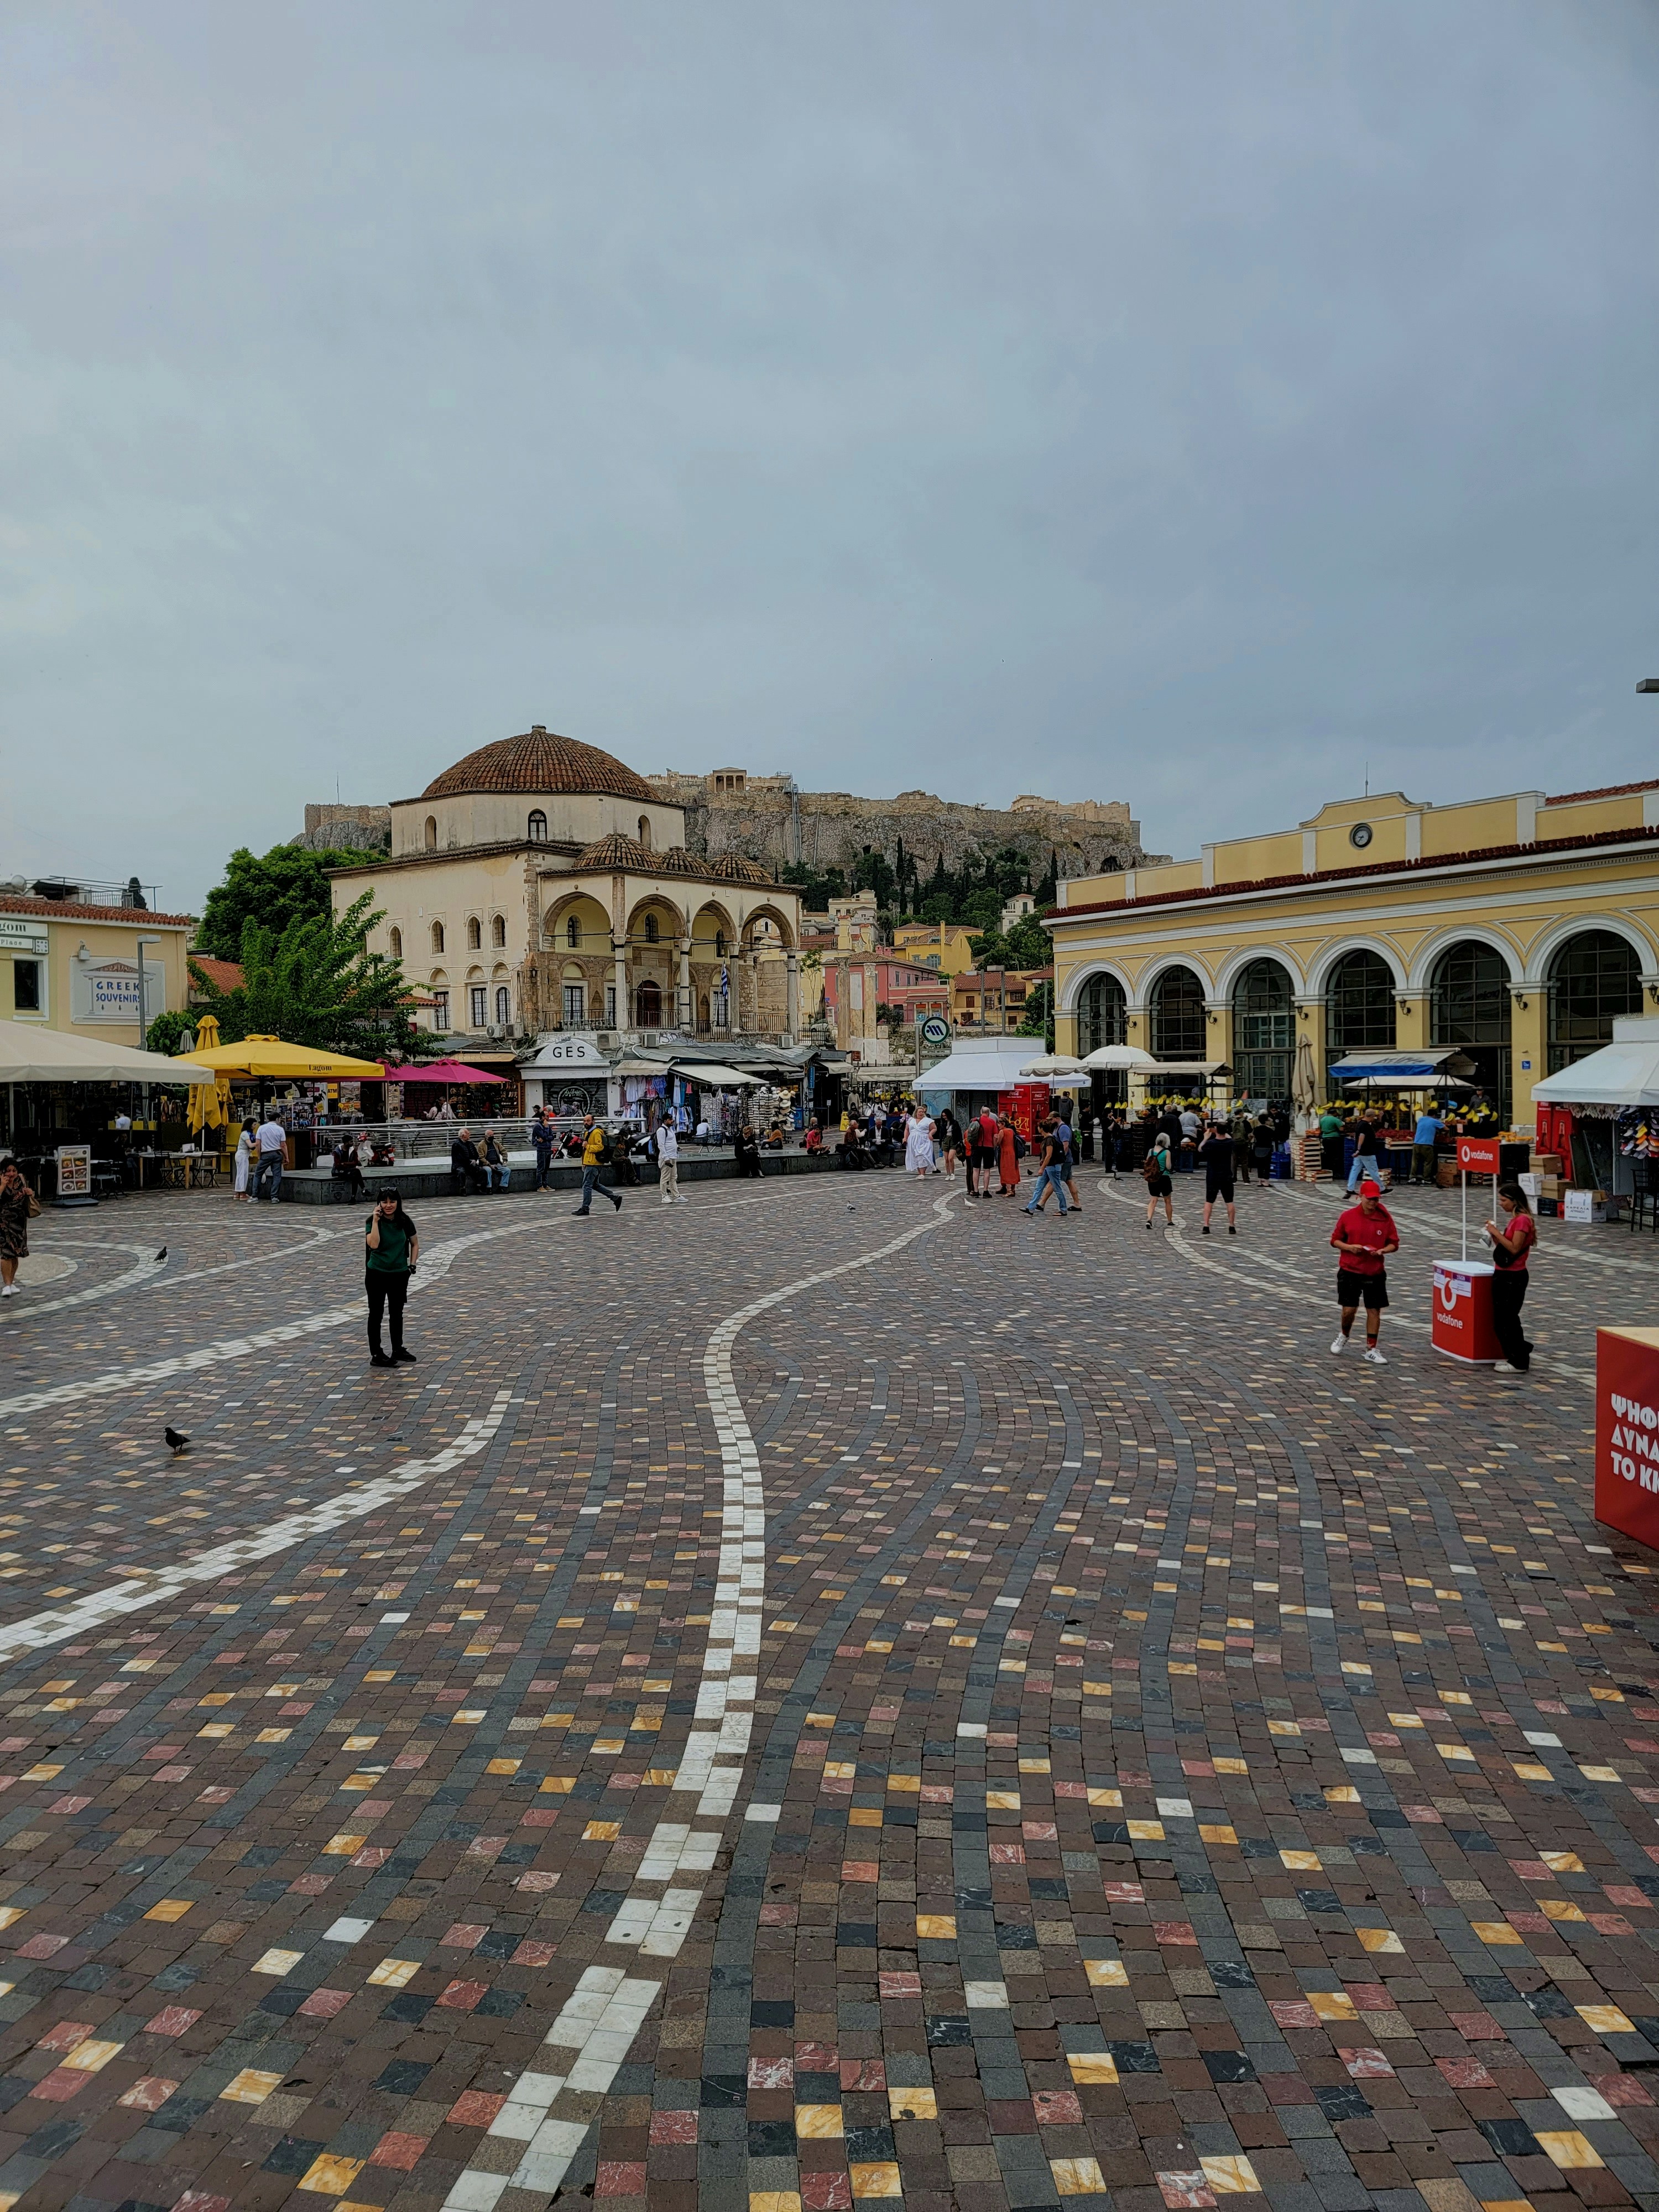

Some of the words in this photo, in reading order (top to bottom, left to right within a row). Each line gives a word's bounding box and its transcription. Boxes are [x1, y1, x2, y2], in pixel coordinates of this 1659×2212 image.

[96, 981, 139, 991] GREEK
[553, 1046, 585, 1057] GES
[1471, 1150, 1493, 1161] vodafone
[1437, 1312, 1463, 1329] vodafone
[1611, 1392, 1659, 1433] ΨΗΦ
[1610, 1451, 1635, 1481] ΤΟ
